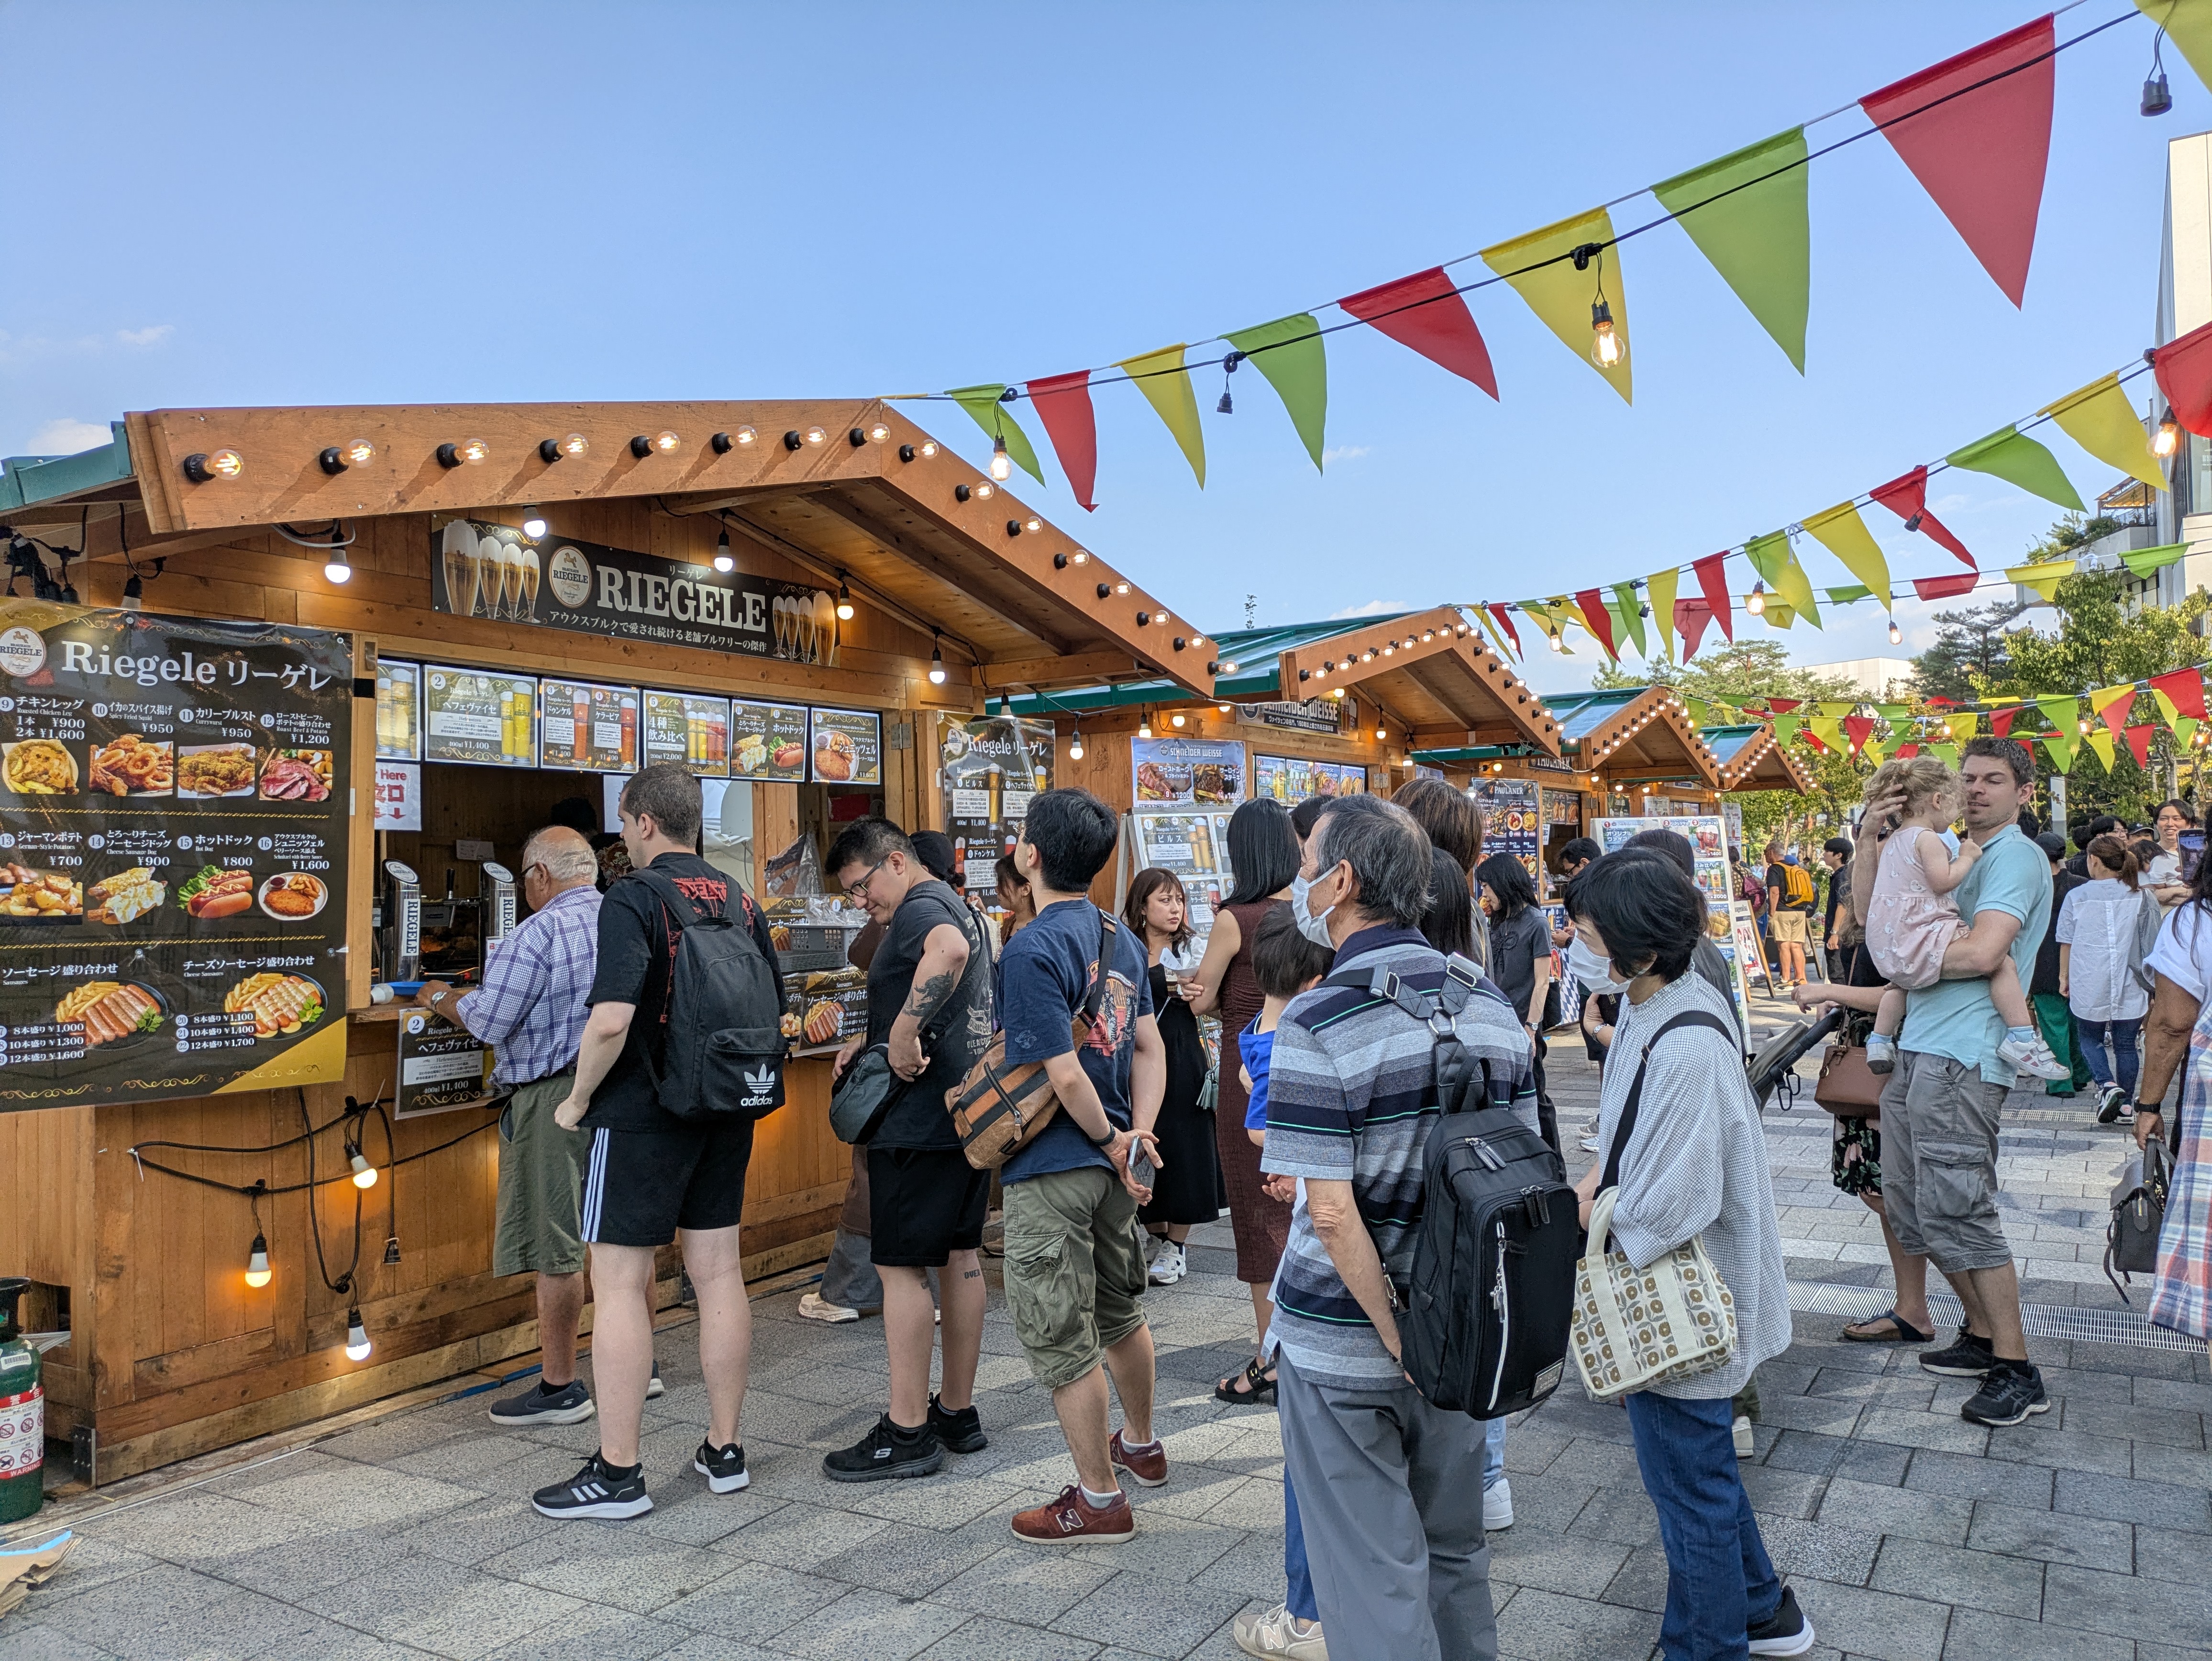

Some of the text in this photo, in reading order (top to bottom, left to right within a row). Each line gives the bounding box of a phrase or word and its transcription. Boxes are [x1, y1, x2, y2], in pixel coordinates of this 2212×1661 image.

[553, 570, 588, 584] RIEGELE
[669, 565, 703, 580] リーゲレ
[597, 565, 766, 632] RIEGELE
[550, 610, 767, 652] アウクスブルクで愛され続ける老舗ブルワリーの傑作
[0, 647, 42, 656] RIEGELE
[62, 641, 332, 691] Riegele リーゲレ
[450, 687, 471, 696] Riegele
[16, 697, 85, 709] チキンレッグ
[109, 702, 173, 716] イカのスパイス揚げ
[443, 702, 497, 714] ヘフェヴァイセ
[196, 708, 256, 721] カリーブルスト
[547, 706, 572, 715] ドゥンケル
[596, 711, 619, 721] ケラービア
[17, 717, 85, 729] 1本 ¥900
[276, 713, 323, 721] ローストビーフと
[649, 716, 667, 729] 4種
[142, 723, 174, 733] ¥950
[276, 720, 332, 729] ポテトの盛り合わせ
[16, 728, 85, 740] 2本 ¥1,600
[222, 728, 252, 738] ¥950
[291, 734, 329, 744] ¥1,200
[648, 729, 685, 742] 飲み比べ
[465, 741, 489, 750] ¥1,400
[840, 742, 876, 755] シュニッツェル
[967, 734, 1047, 757] Riegele リーゲレ
[1170, 747, 1222, 757] SCHNEIDER WEISSE
[381, 769, 407, 780] Here
[965, 779, 983, 788] ピルス
[1011, 781, 1033, 789] ヘフェヴァイセ
[1494, 786, 1523, 795] PAULANER
[18, 831, 83, 842] ジャーマンポテト
[195, 834, 253, 846] ホットドック
[1158, 835, 1183, 843] ピルス
[107, 839, 172, 848] ソーセージドッグ
[974, 850, 995, 858] ドゥンケル
[50, 856, 82, 866] ¥700
[137, 856, 170, 866] ¥900
[223, 857, 253, 866] ¥800
[292, 860, 330, 870] ¥1,600
[405, 900, 419, 953] RIEGELE
[183, 956, 315, 970] チーズソーセージ盛り合わせ
[3, 963, 119, 978] ソーセージ盛り合わせ
[194, 1013, 254, 1024] 8本盛り ¥1,100
[13, 1023, 84, 1035] 8本盛り ¥1,000
[191, 1025, 254, 1037] 10本盛り ¥1,400
[428, 1026, 452, 1035] Riegele
[10, 1037, 84, 1049] 10本盛り ¥1,300
[191, 1038, 255, 1050] 12本盛り ¥1,700
[419, 1039, 478, 1052] ヘフェヴァイセ
[10, 1051, 84, 1063] 12本盛り ¥1,600
[442, 1080, 468, 1091] ¥1,400
[741, 1096, 773, 1107] adidas
[10, 1462, 40, 1477] WARNING
[1056, 1509, 1084, 1532] N
[1262, 1624, 1284, 1649] N
